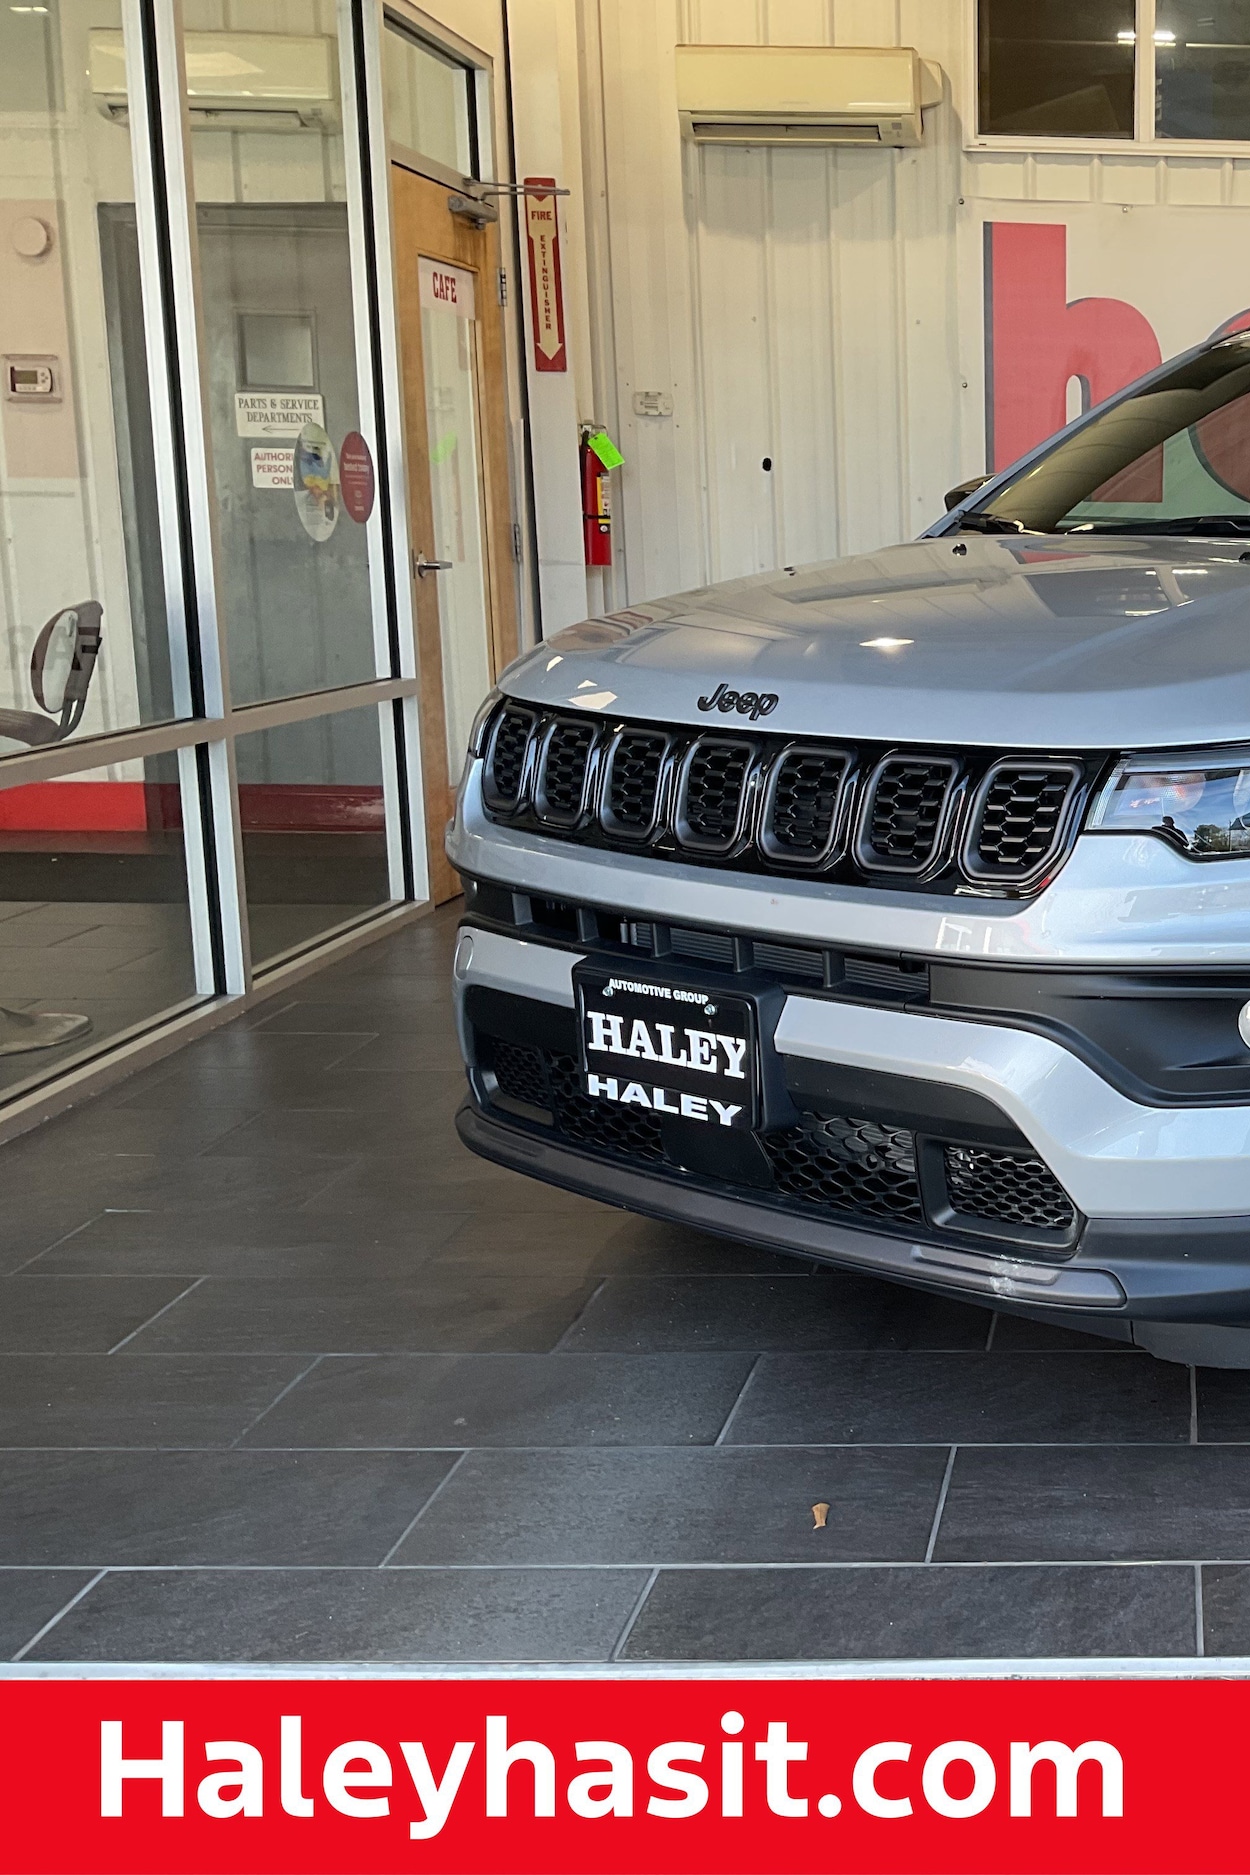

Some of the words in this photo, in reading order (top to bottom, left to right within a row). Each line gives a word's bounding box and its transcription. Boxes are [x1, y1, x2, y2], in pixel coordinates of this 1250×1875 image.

[531, 210, 552, 221] FIRE
[432, 271, 457, 304] CAFE
[539, 234, 552, 331] EXTINGUISHER
[238, 398, 268, 409] PARTS
[270, 399, 277, 409] &
[280, 399, 320, 410] SERVICE
[246, 411, 313, 424] DEPARTMENTS
[272, 476, 294, 486] ONL
[697, 683, 780, 722] Jeep
[608, 978, 672, 999] AUTOMOTIVE
[673, 989, 709, 1004] GROUP
[587, 1010, 747, 1079] HALEY
[587, 1073, 743, 1127] HALEY
